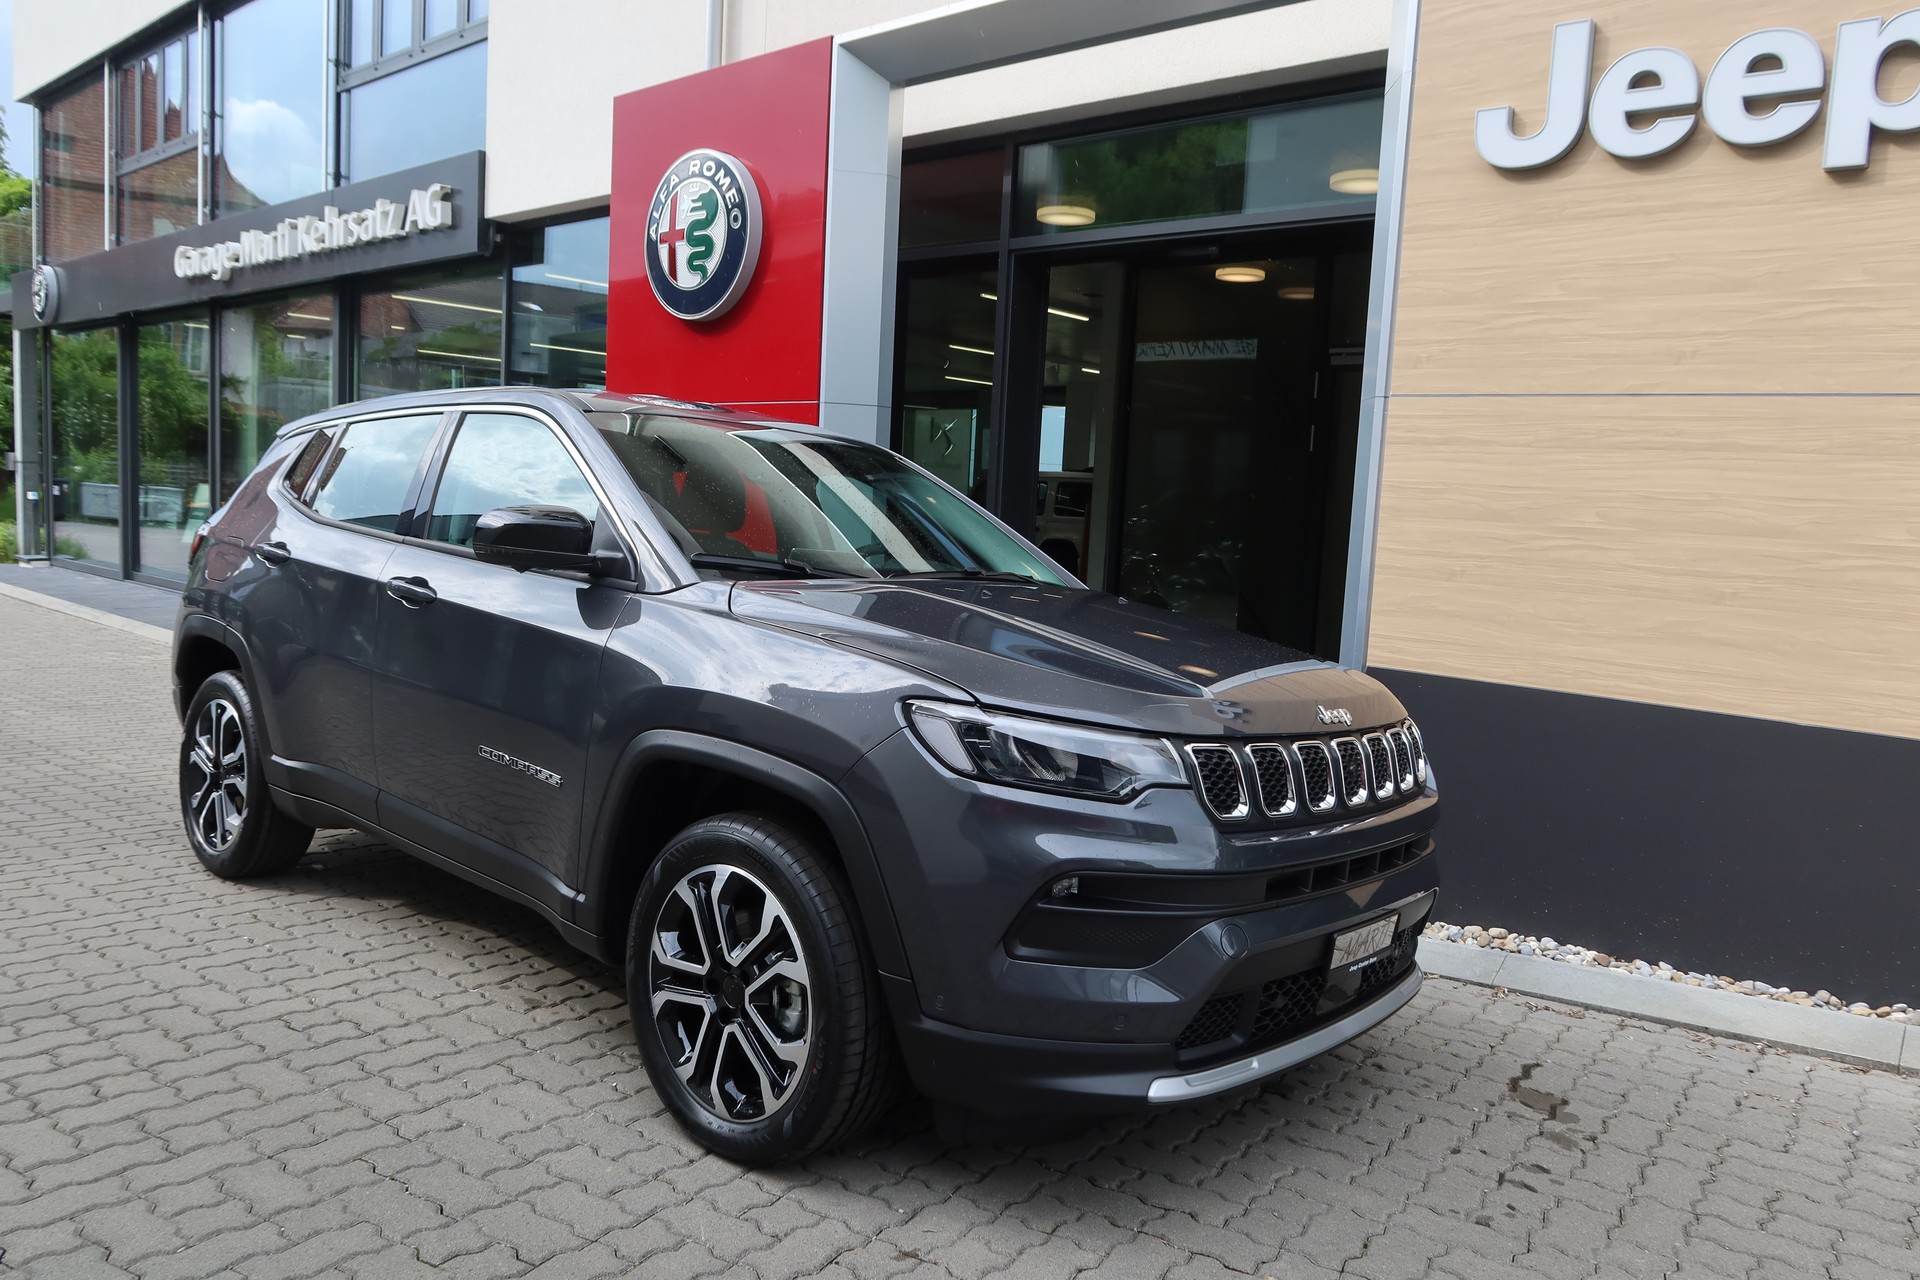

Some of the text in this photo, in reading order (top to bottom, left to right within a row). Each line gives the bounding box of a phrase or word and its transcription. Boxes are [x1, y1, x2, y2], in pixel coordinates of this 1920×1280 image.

[1474, 8, 1920, 173] Jeep
[173, 241, 241, 281] Garage
[297, 198, 407, 256] Kehrsatz
[404, 182, 452, 233] AG
[649, 159, 742, 242] ALFA ROMEO
[1316, 705, 1353, 727] Jeep
[478, 744, 564, 788] COMPASS
